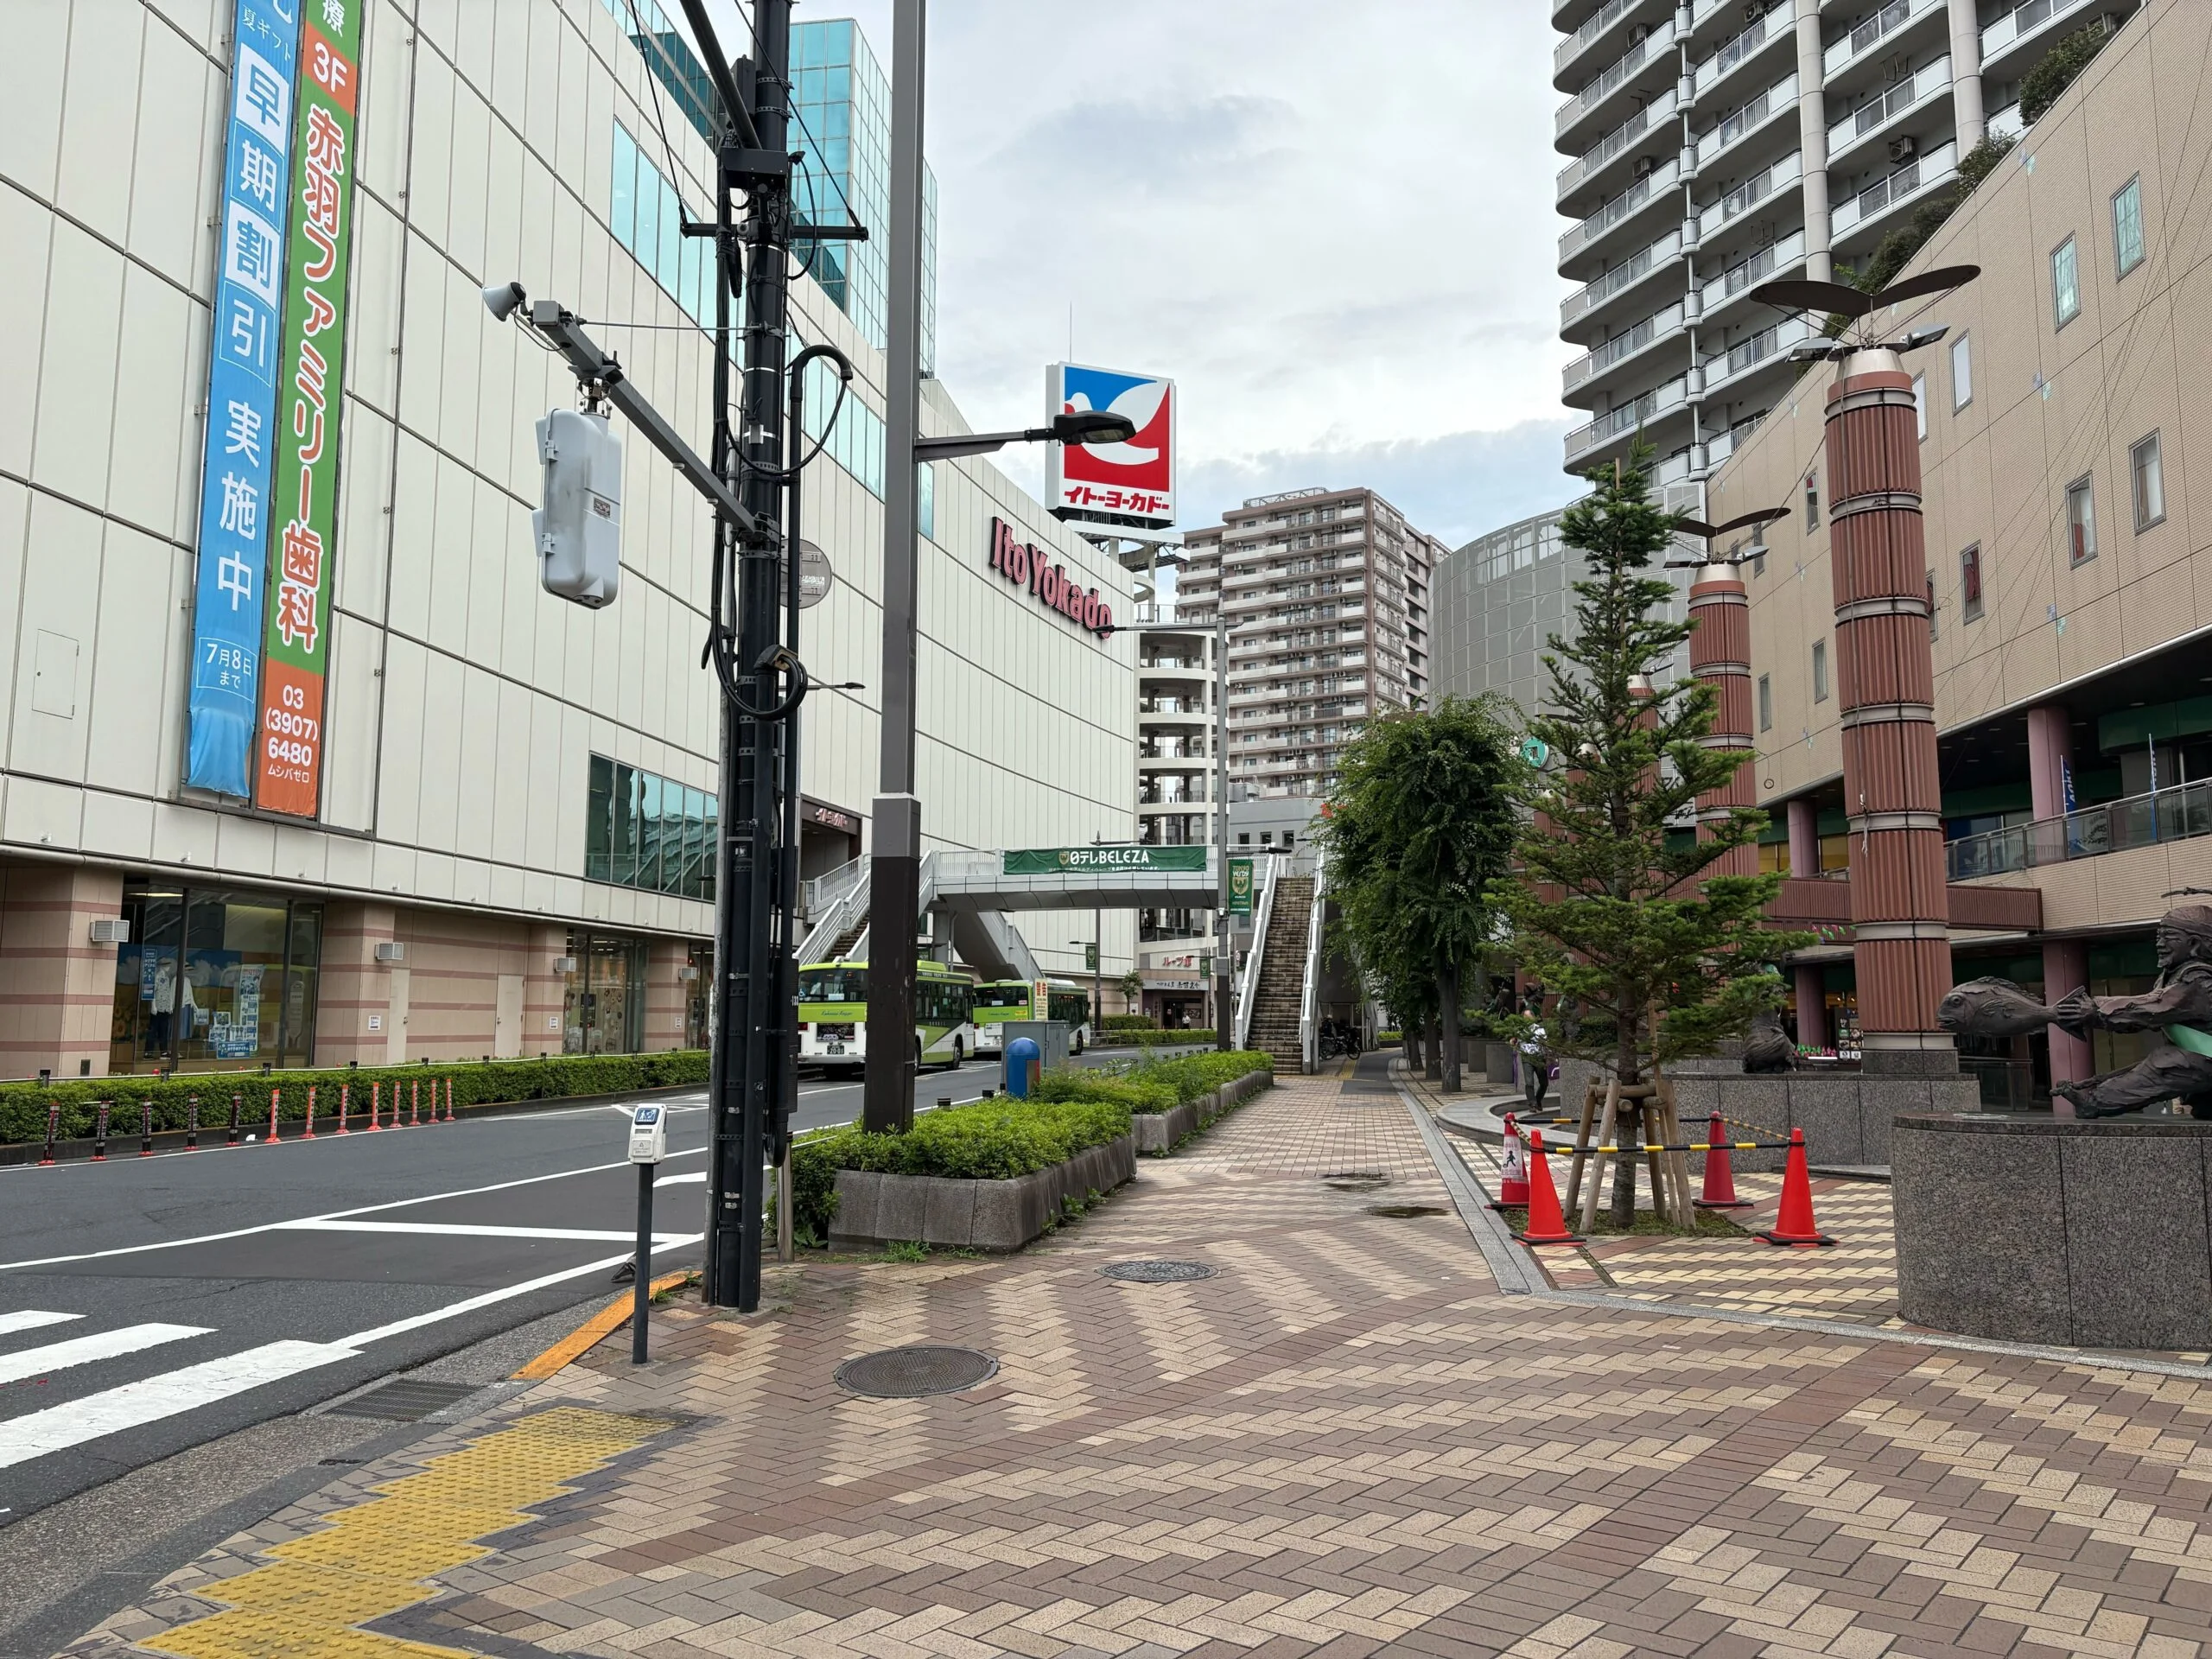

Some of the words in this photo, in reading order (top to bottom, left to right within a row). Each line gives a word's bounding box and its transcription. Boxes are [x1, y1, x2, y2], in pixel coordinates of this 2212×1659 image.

[242, 4, 291, 61] 夏ギフト
[313, 41, 346, 92] 3F
[1064, 486, 1170, 513] イトーヨーカドー
[207, 643, 251, 677] 7月8日
[219, 671, 241, 689] まで
[283, 684, 304, 709] 03
[265, 707, 318, 741] (3907)
[268, 737, 312, 767] 6480
[268, 764, 309, 784] ムシバゼロ
